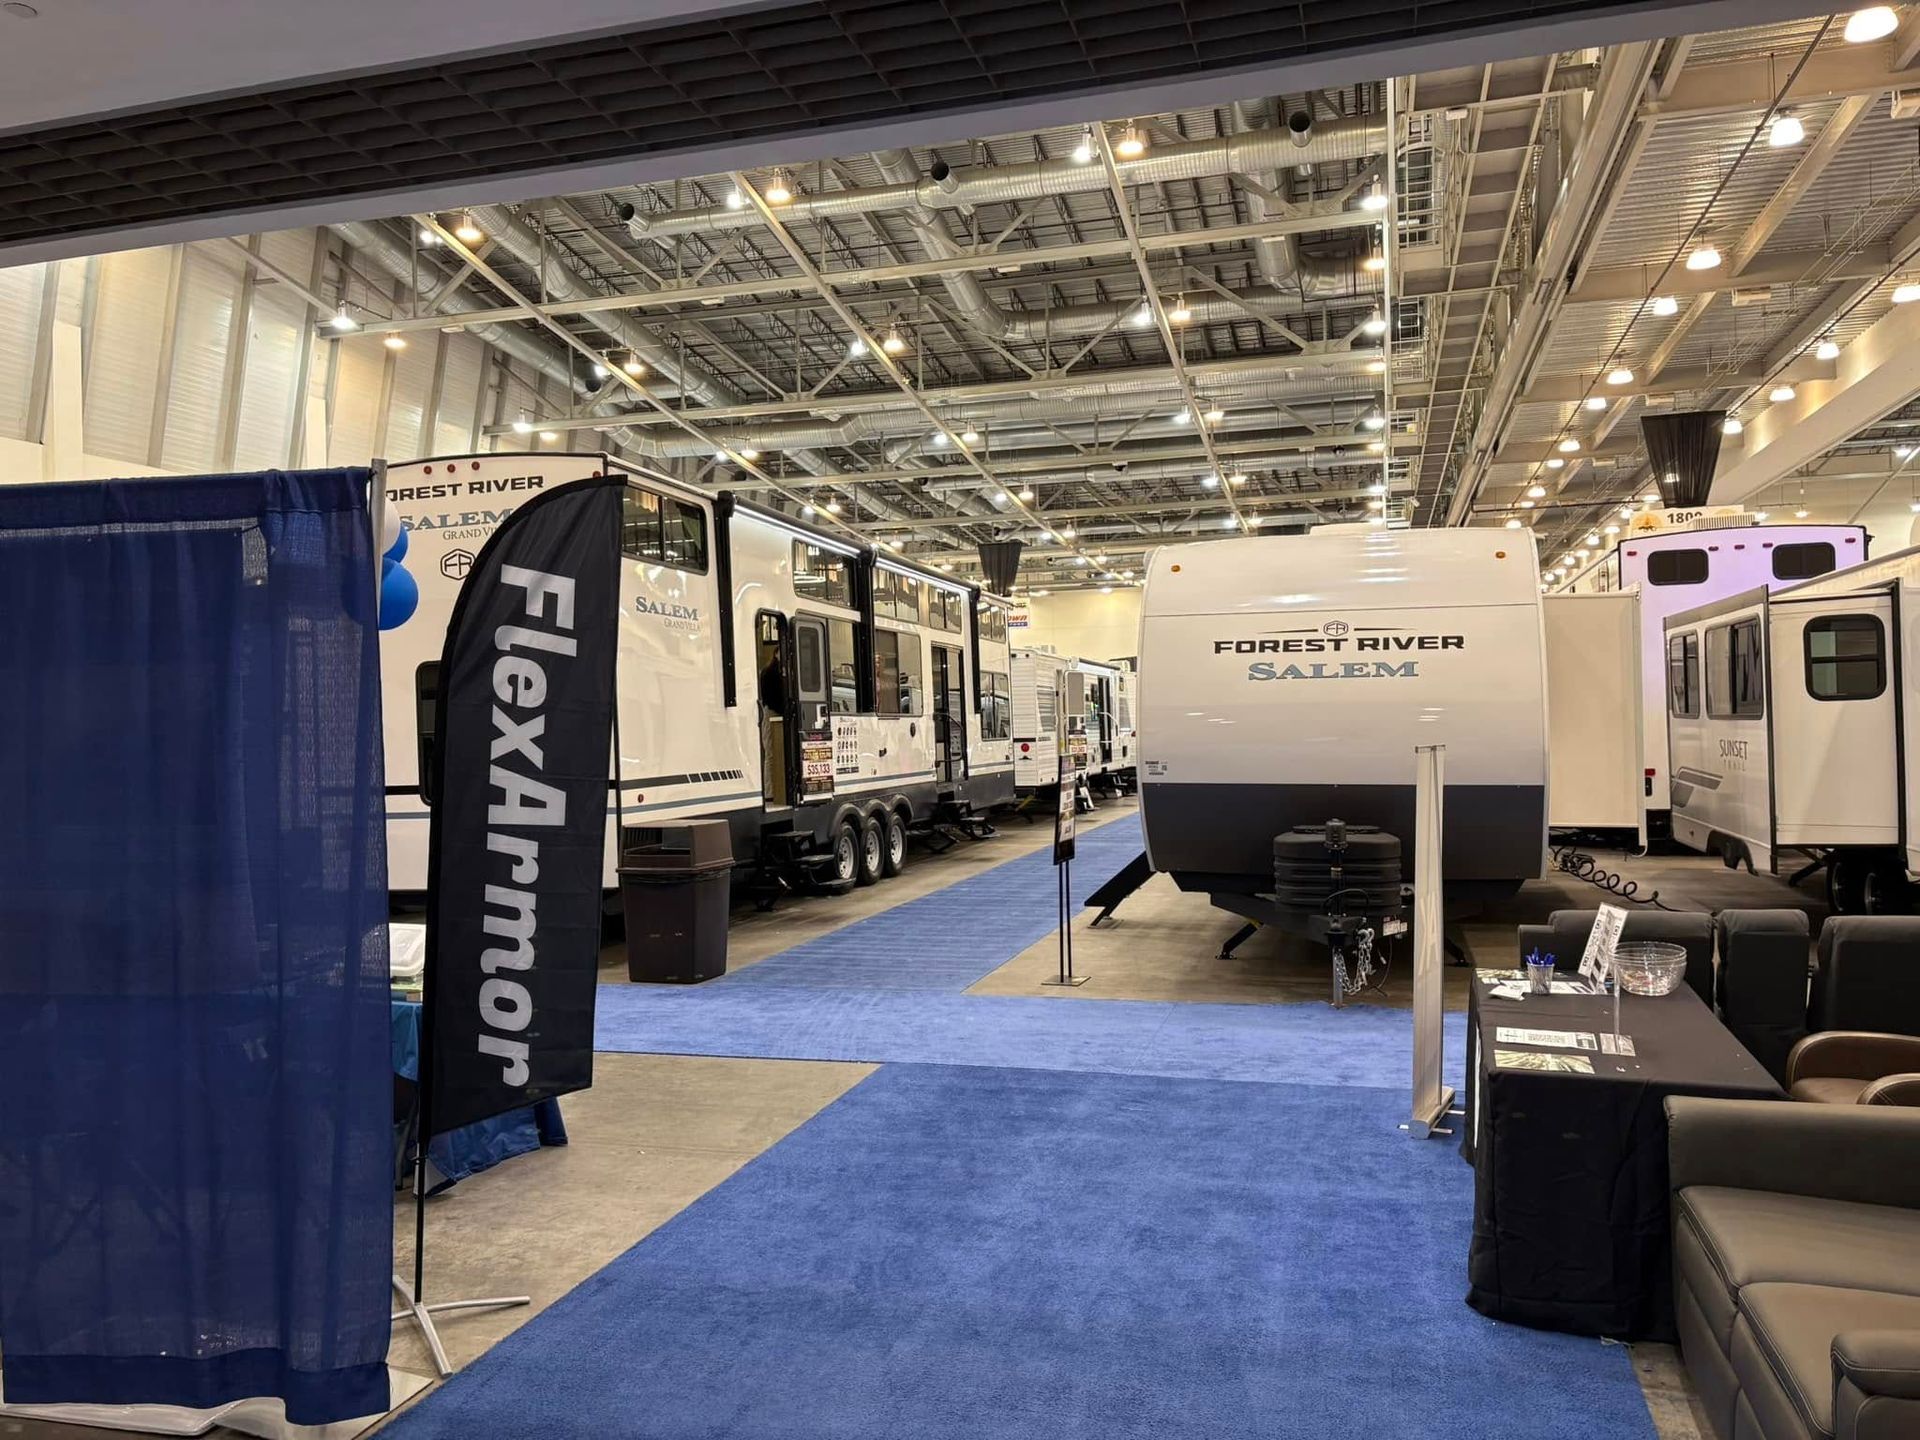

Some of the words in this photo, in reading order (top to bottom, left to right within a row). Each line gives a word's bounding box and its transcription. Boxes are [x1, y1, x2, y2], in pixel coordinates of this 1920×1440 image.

[468, 475, 544, 495] RIVER
[400, 508, 514, 532] SALEM
[442, 528, 482, 541] GRAND
[635, 596, 699, 621] SALEM
[1213, 638, 1348, 654] FOREST
[1356, 635, 1465, 651] RIVER
[1248, 661, 1420, 681] SALEM
[1719, 739, 1748, 760] SUNSET
[477, 563, 578, 1088] FlexArmor
